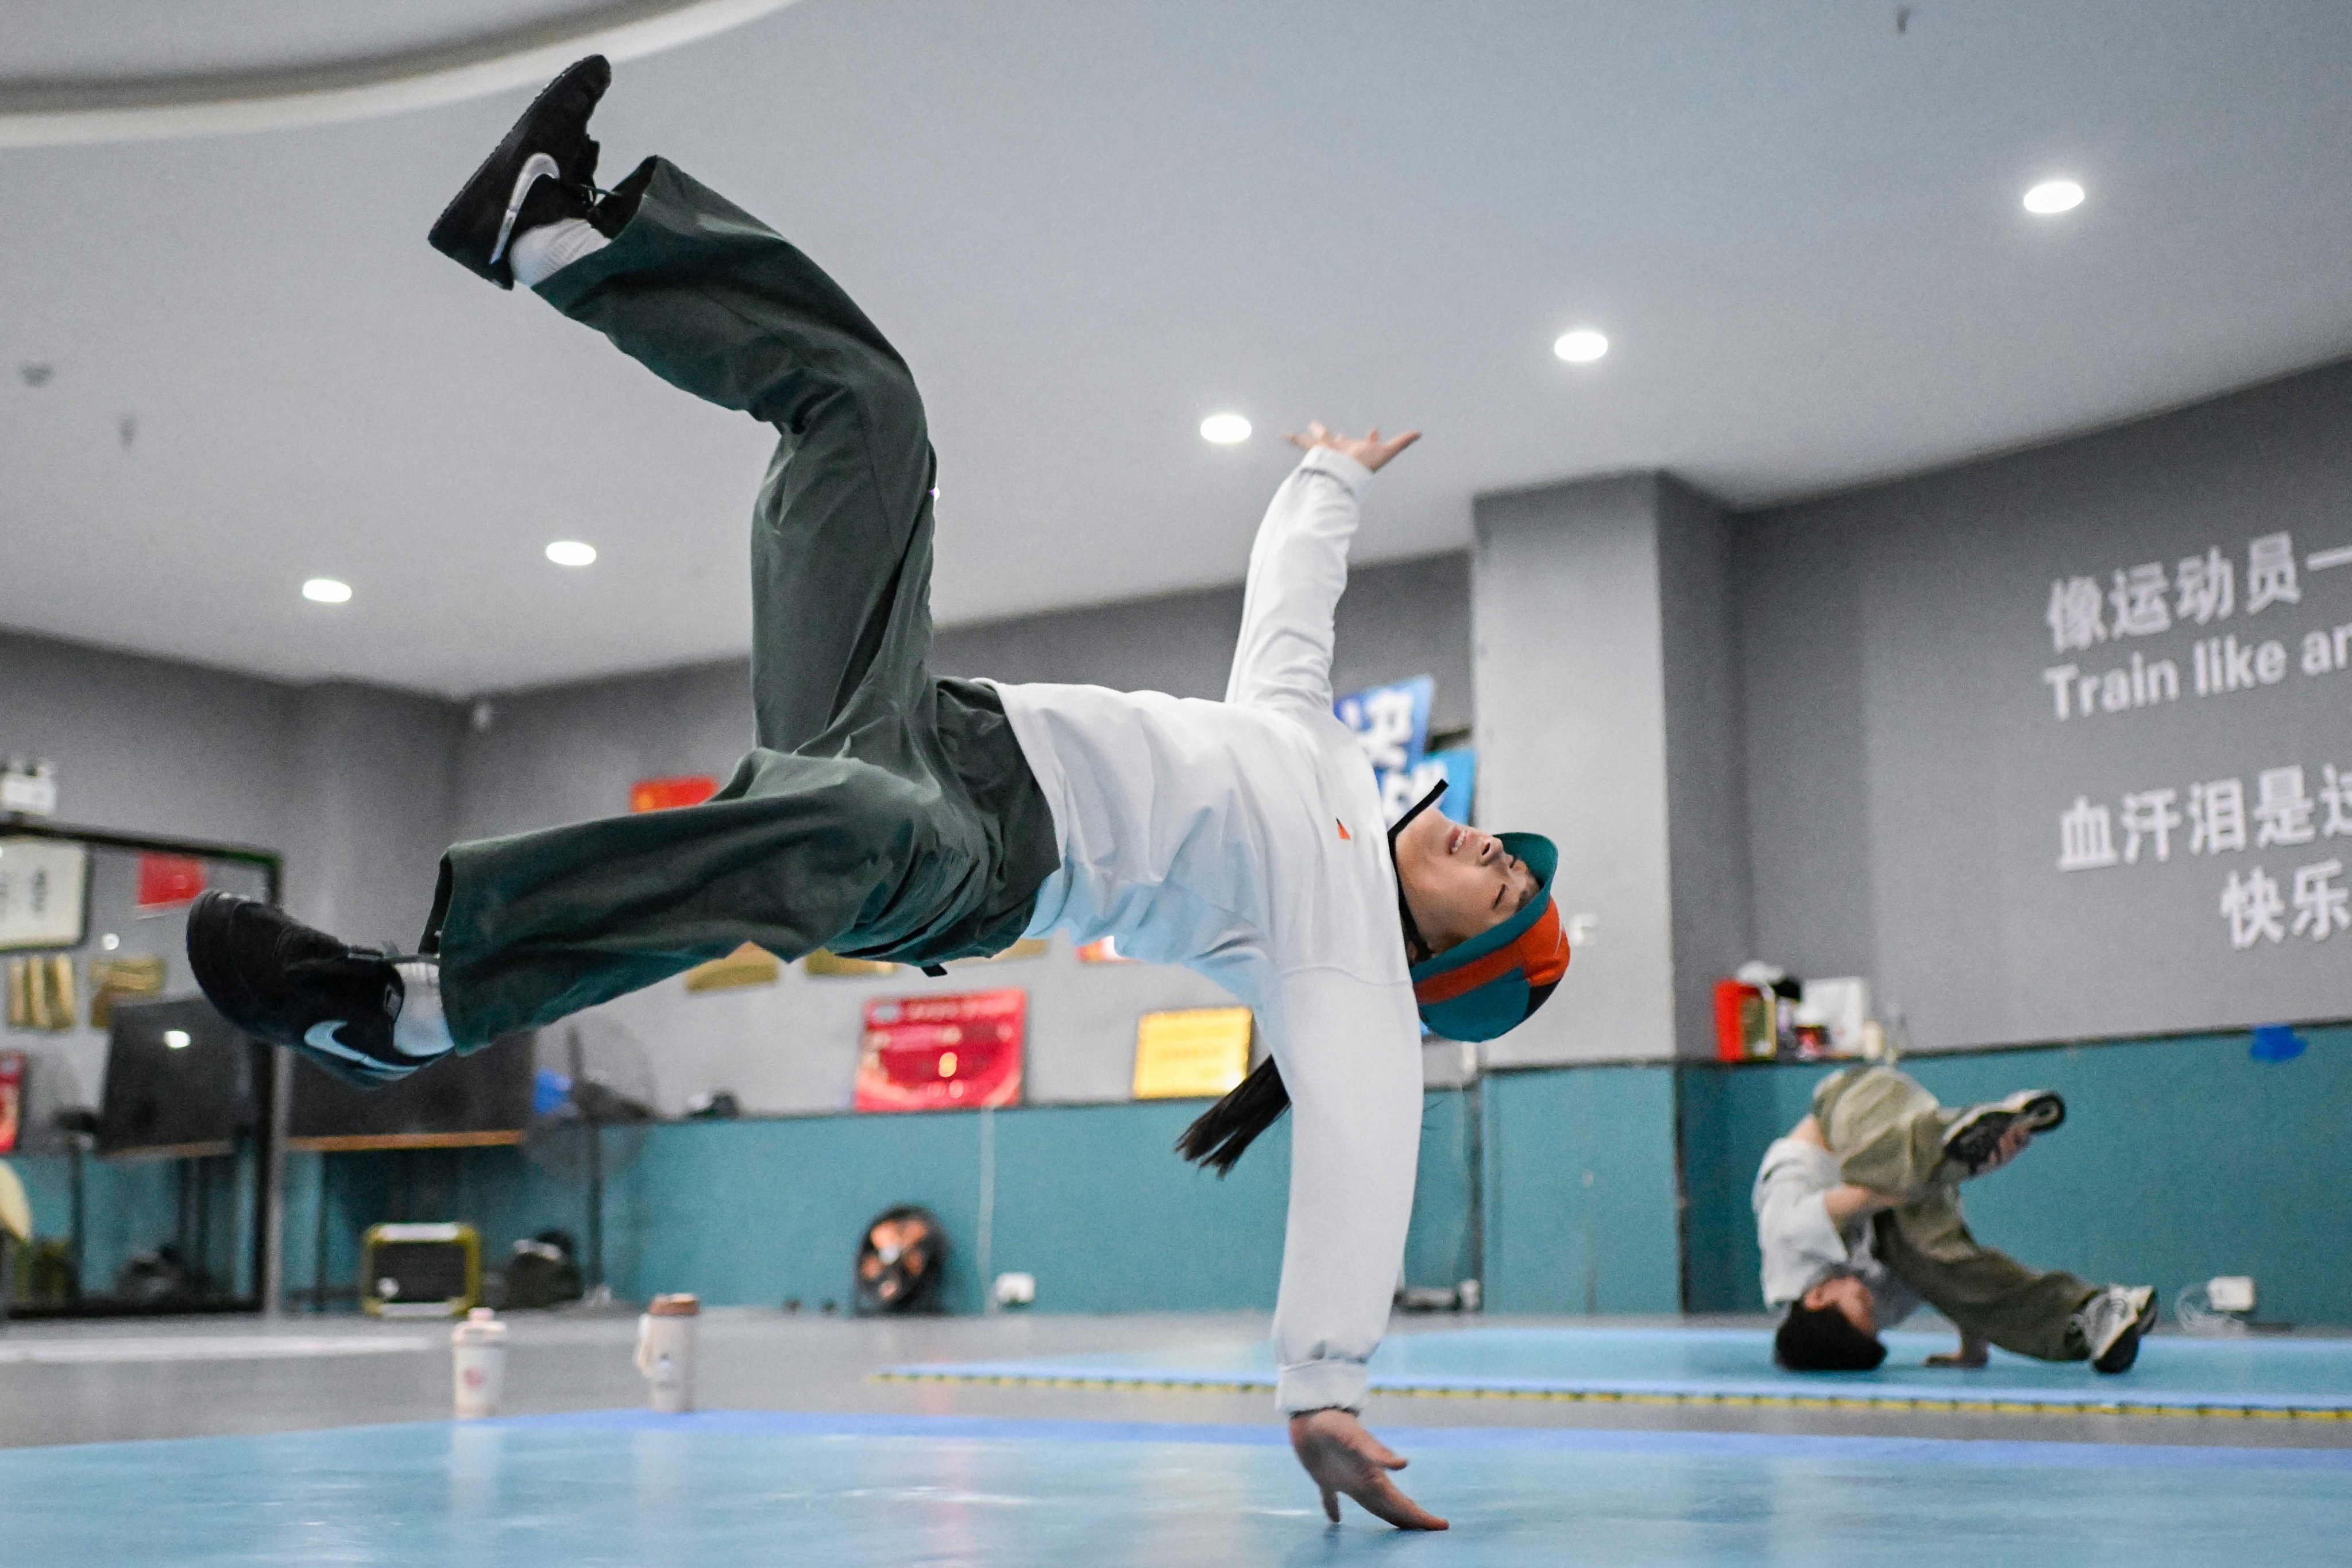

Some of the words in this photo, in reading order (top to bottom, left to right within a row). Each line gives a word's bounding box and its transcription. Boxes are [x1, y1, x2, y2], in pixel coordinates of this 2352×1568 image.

[2046, 530, 2352, 652] 像运动员一
[2043, 652, 2180, 720] Train
[2193, 635, 2288, 696] like
[2219, 859, 2352, 948] 快乐
